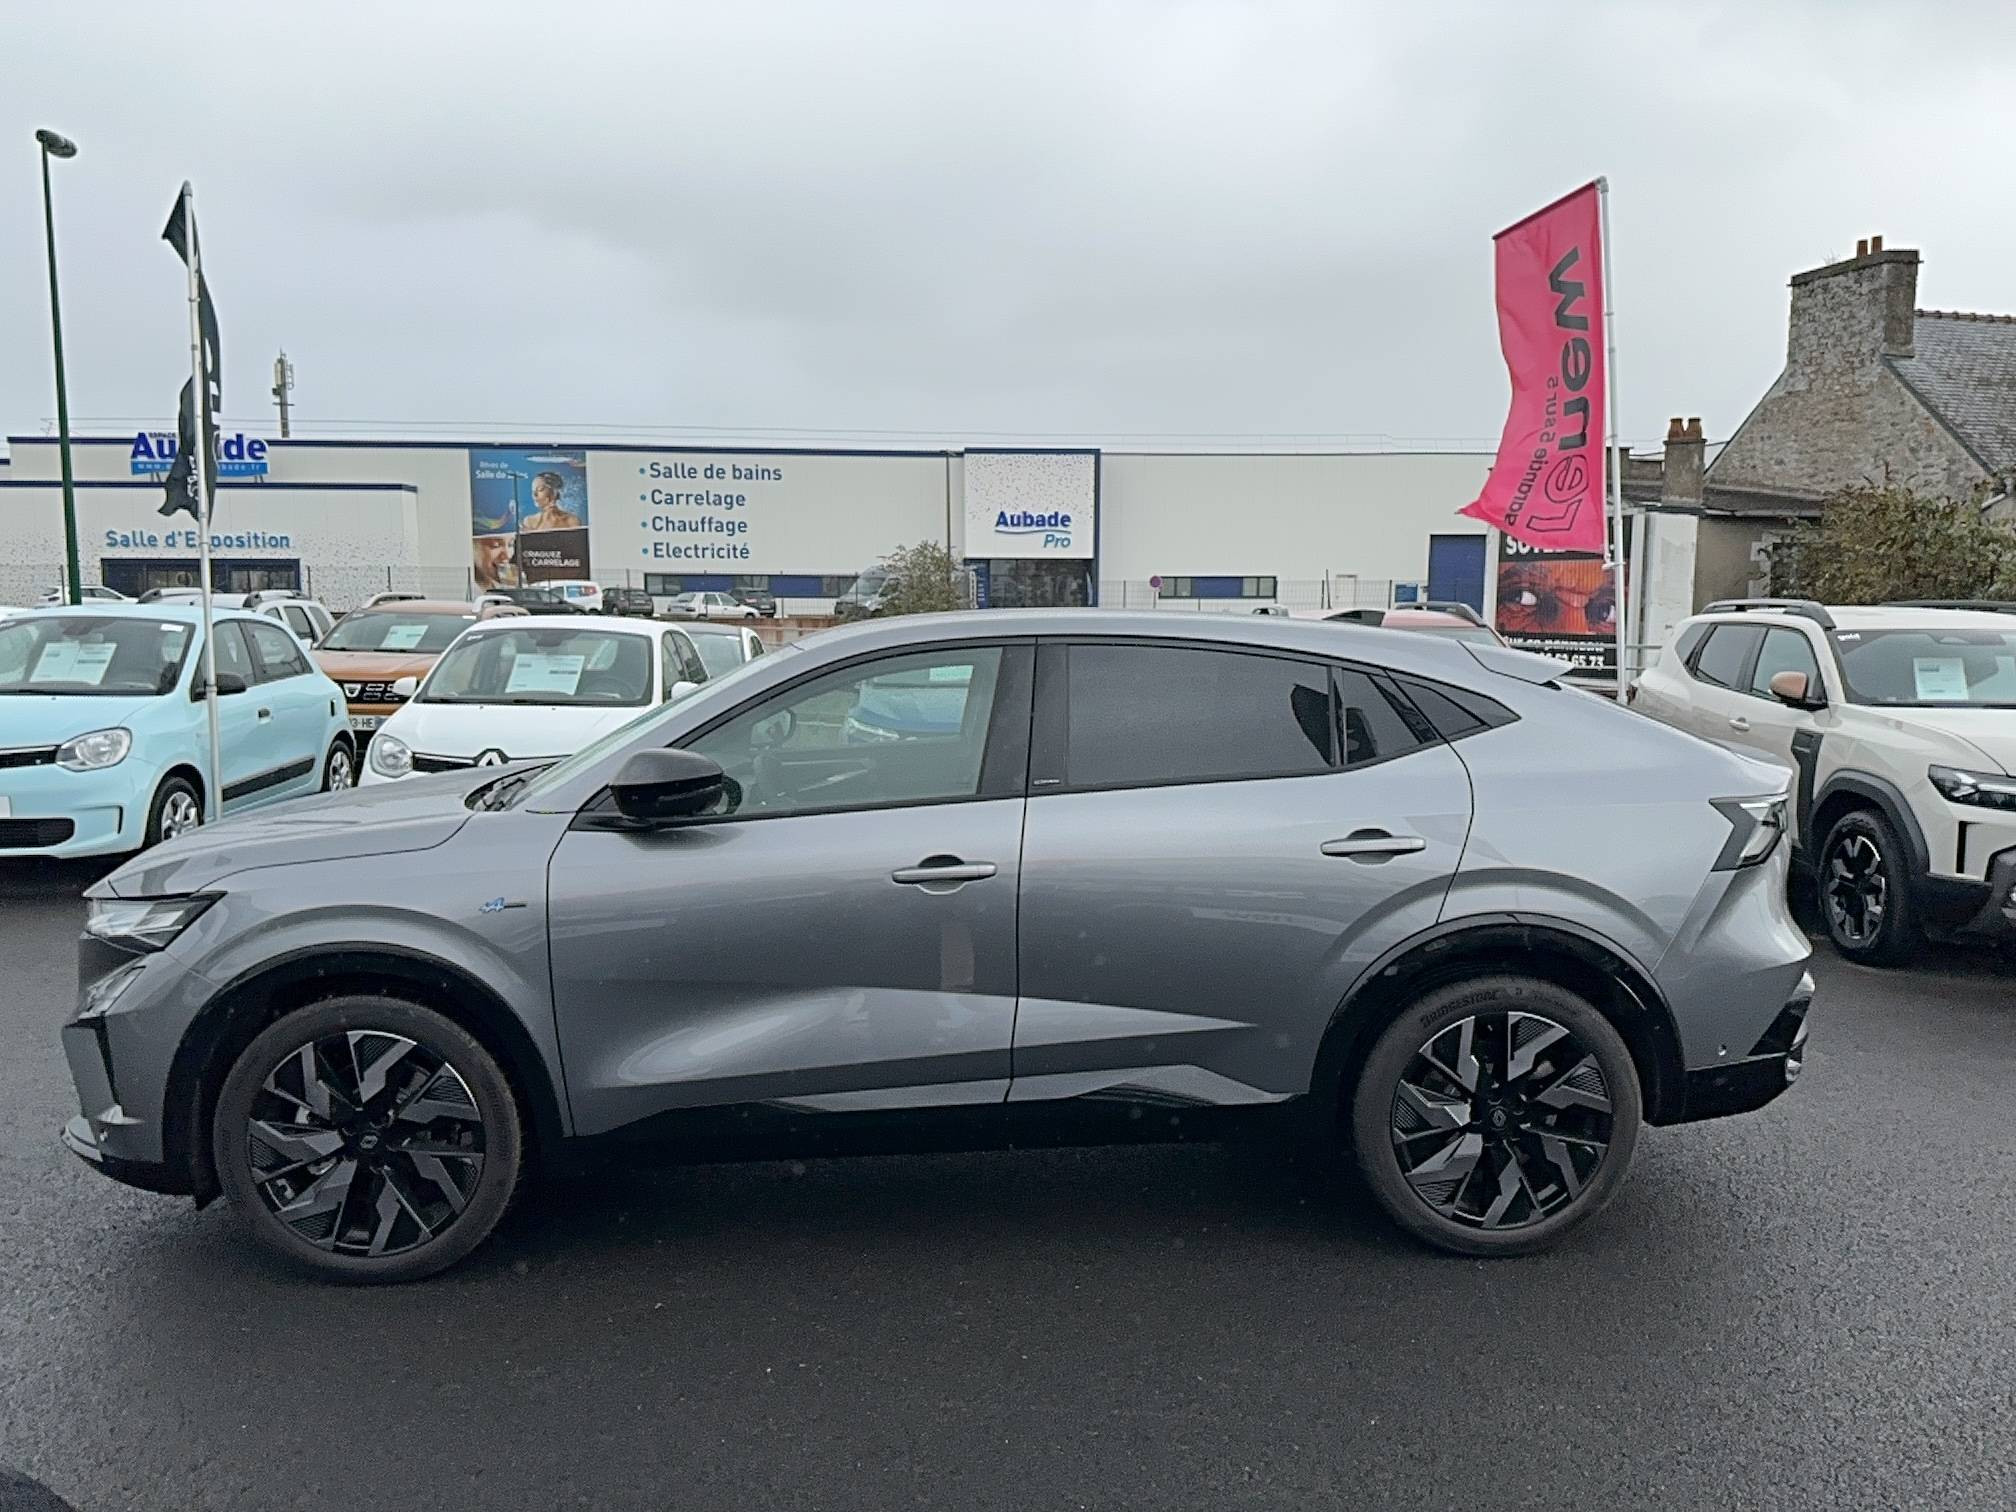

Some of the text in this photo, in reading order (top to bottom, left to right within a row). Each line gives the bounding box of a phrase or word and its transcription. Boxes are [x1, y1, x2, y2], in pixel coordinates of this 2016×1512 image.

[131, 431, 267, 460] Aude
[649, 462, 782, 481] Salle de bains
[651, 488, 746, 510] Carrelage
[651, 515, 748, 537] Chauffage
[995, 511, 1071, 527] Aubade
[106, 530, 291, 551] Salle d'Eposition
[653, 542, 750, 559] Electricité
[1043, 534, 1071, 548] Pro
